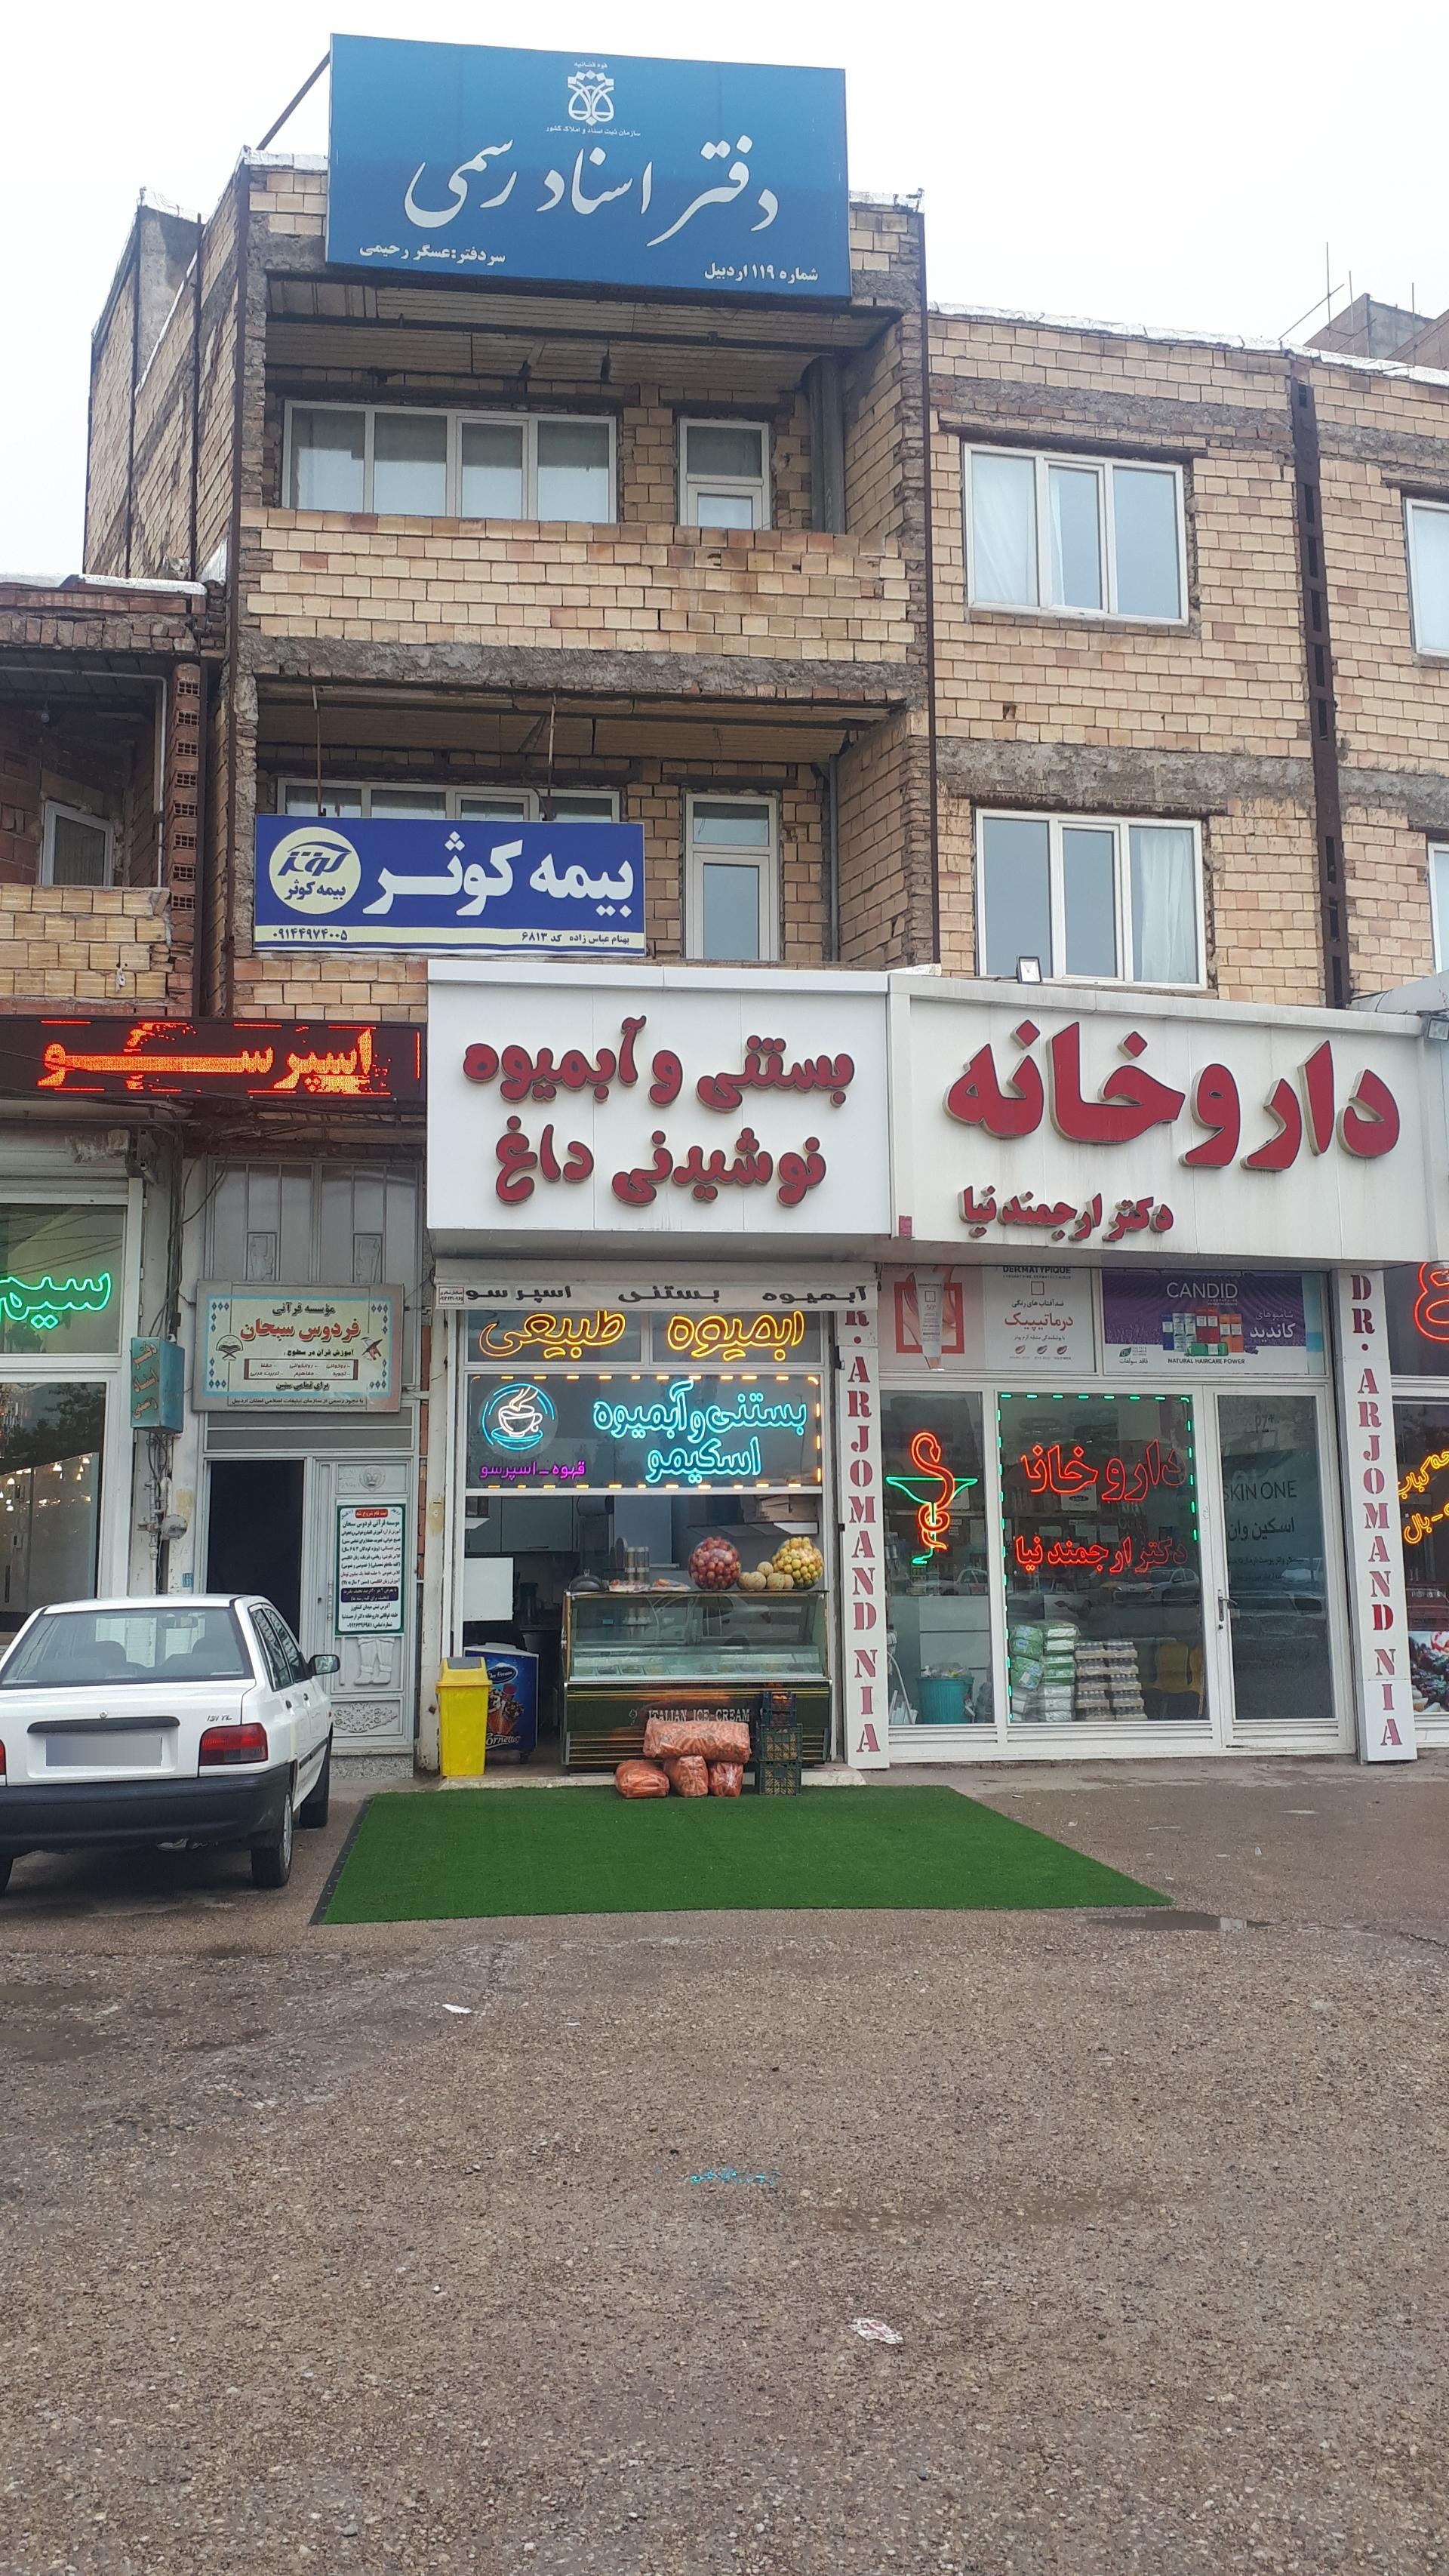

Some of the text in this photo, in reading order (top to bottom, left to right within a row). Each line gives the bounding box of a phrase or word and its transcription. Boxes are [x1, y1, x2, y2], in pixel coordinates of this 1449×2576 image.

[404, 134, 779, 248] دفتر اسناد رسمی
[359, 243, 410, 260] رحیمی
[704, 262, 819, 285] شماره ۱۱۹ اردبیل
[362, 830, 635, 919] بیمه کوثر
[284, 879, 346, 901] بیمه کوثر
[272, 927, 348, 942] ۰۹۱۴۴۹۷۴۰۰۵
[521, 931, 630, 946] بهنام عباس زاده کد ۶۸۱۳
[462, 1014, 856, 1115] بستنی و آبمیوه
[942, 1018, 1401, 1172] داروخانه
[494, 1115, 828, 1208] نوشیدنی داغ
[1102, 1195, 1175, 1242] دکتر
[1002, 1263, 1072, 1274] DERMATYPIQUE
[617, 1285, 721, 1304] بستنی
[1166, 1282, 1239, 1300] CANDID
[1011, 1299, 1026, 1308] رنگی
[240, 1318, 361, 1343] فردوس سبحان
[1004, 1312, 1074, 1332] درماتیپیک
[1249, 1322, 1297, 1343] کاندید
[592, 1378, 808, 1443] بستنی و آبمیوه
[480, 1460, 586, 1481] قهوه اسپرسو
[645, 1436, 761, 1484] اسکیمو
[846, 1356, 879, 1633] ARJOMAND
[1260, 1479, 1298, 1500] ONE
[1357, 1367, 1395, 1633] ARJOMAND
[1251, 1517, 1295, 1541] اسکین
[648, 1708, 750, 1722] ITALIAN ICE-CREAM
